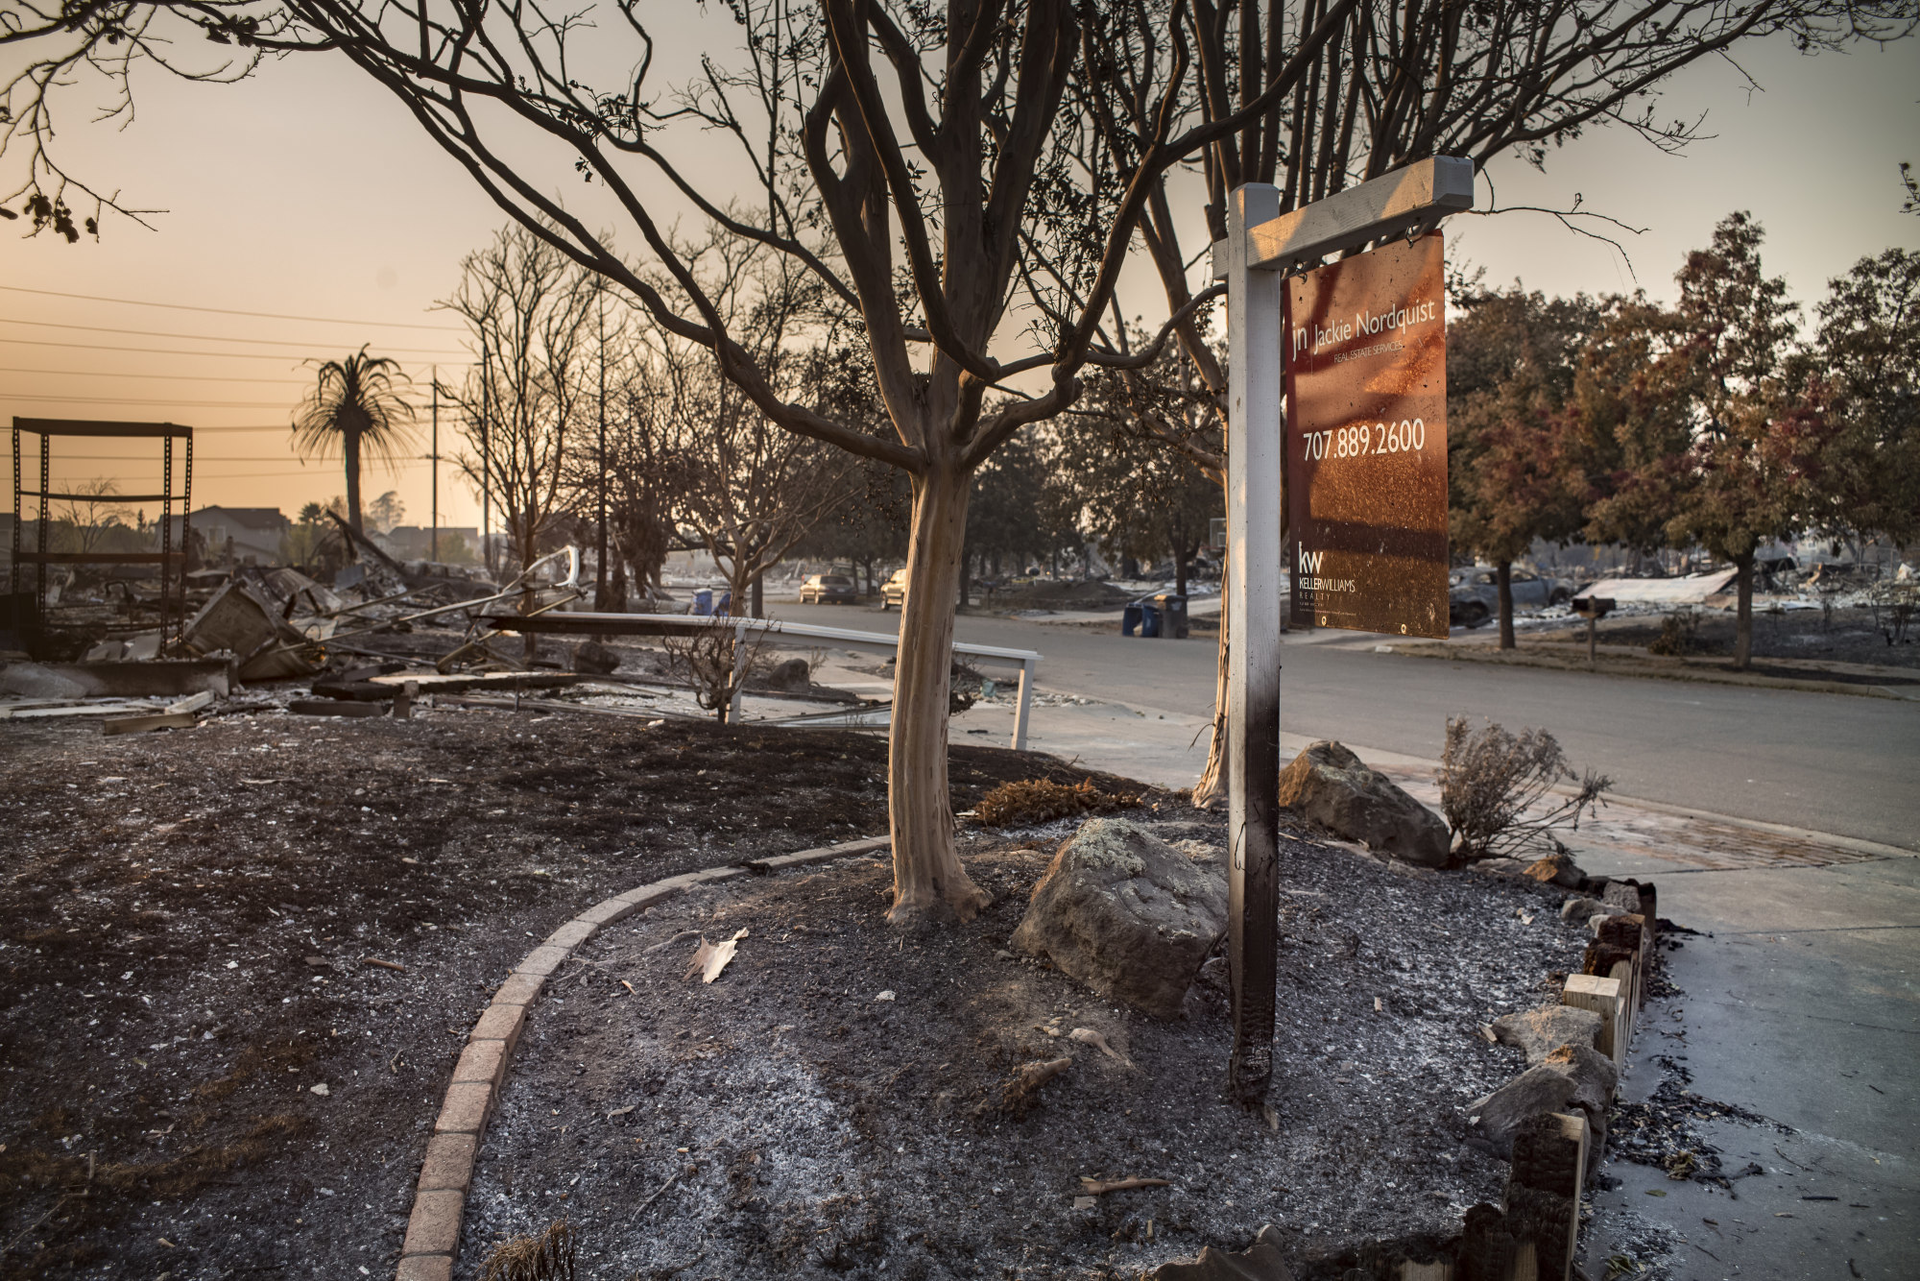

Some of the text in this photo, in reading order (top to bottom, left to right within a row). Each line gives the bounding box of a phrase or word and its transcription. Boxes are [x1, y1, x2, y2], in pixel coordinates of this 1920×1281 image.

[1292, 299, 1435, 362] jn Jackie Nordquist
[1372, 340, 1402, 354] SERVICES
[1303, 418, 1425, 461] 707.889.2600
[1298, 541, 1323, 574] kw
[1299, 592, 1330, 600] REALTY
